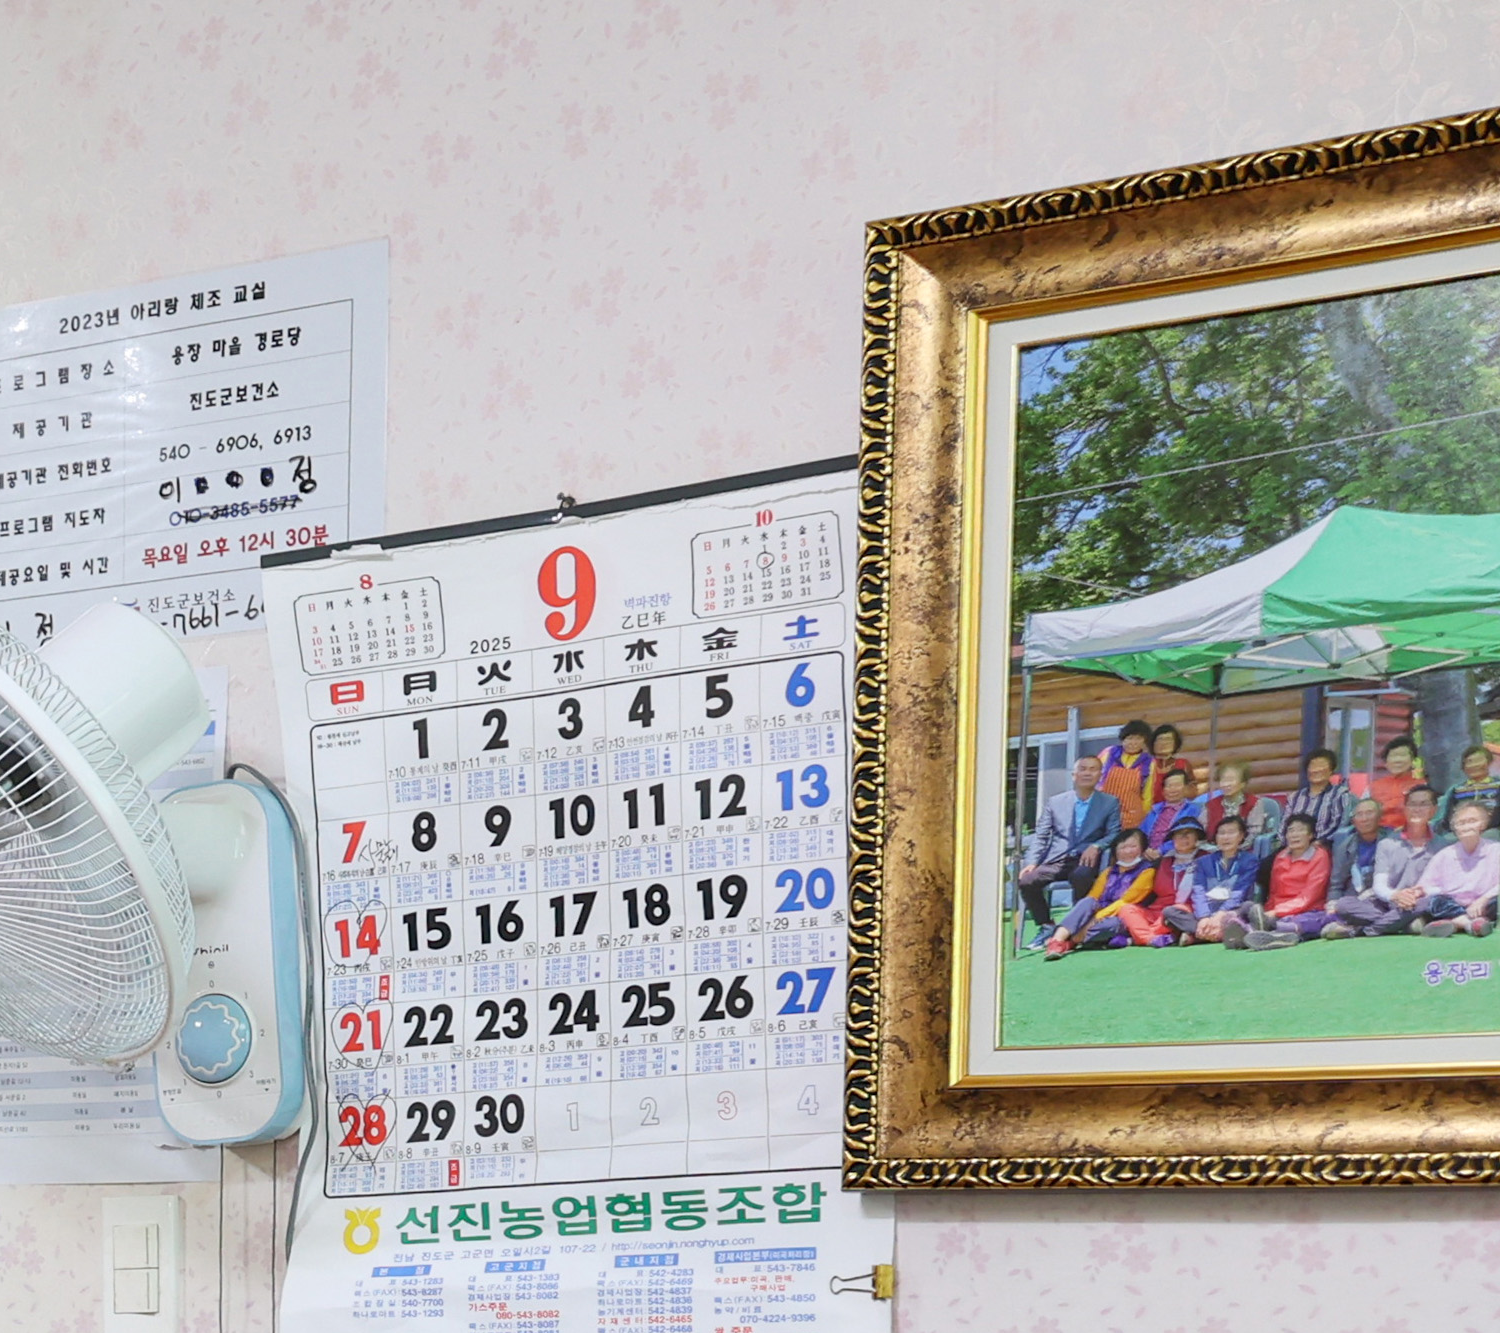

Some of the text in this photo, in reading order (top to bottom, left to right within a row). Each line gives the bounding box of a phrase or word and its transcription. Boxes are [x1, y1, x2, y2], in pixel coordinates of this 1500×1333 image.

[59, 281, 267, 334] 2023년 아리랑 체조 교실
[171, 342, 201, 366] 용장
[212, 335, 242, 359] 마을
[254, 326, 302, 353] 경로당
[189, 381, 280, 411] 진도군보건소
[57, 456, 112, 483] 전화번호
[159, 444, 190, 462] 540
[273, 426, 312, 445] 6913
[0, 511, 54, 538] 프로그램
[63, 506, 105, 529] 지도자
[754, 509, 773, 527] 10
[59, 558, 72, 578] 및
[82, 555, 109, 575] 시간
[141, 542, 188, 567] 목요일
[196, 537, 230, 559] 오후
[238, 530, 275, 553] 12시
[285, 523, 330, 547] 30분
[359, 574, 374, 590] 8
[537, 545, 596, 641] 9
[470, 636, 512, 655] 2025
[621, 611, 666, 630] 乙巳年
[329, 615, 820, 706] 日 月 火 水 木 金 土
[336, 640, 812, 716] SUN MON TUE WED THU FRI SAT
[413, 662, 816, 760] 1 2 3 4 5 6
[342, 763, 831, 864] 7 8 9 10 11 12 13
[334, 866, 836, 959] 14 15 16 17 18 19 20
[1422, 960, 1490, 985] 용장리
[339, 966, 837, 1053] 21 22 23 24 25 26 27
[338, 1084, 820, 1148] 28 29 30 1 2 3 4
[395, 1181, 828, 1245] 선진농업협동조합
[393, 1252, 415, 1263] 전남
[421, 1250, 454, 1262] 진도군
[460, 1249, 494, 1260] 고군면
[559, 1243, 597, 1254] 107-22
[468, 1302, 508, 1312] 가스주문
